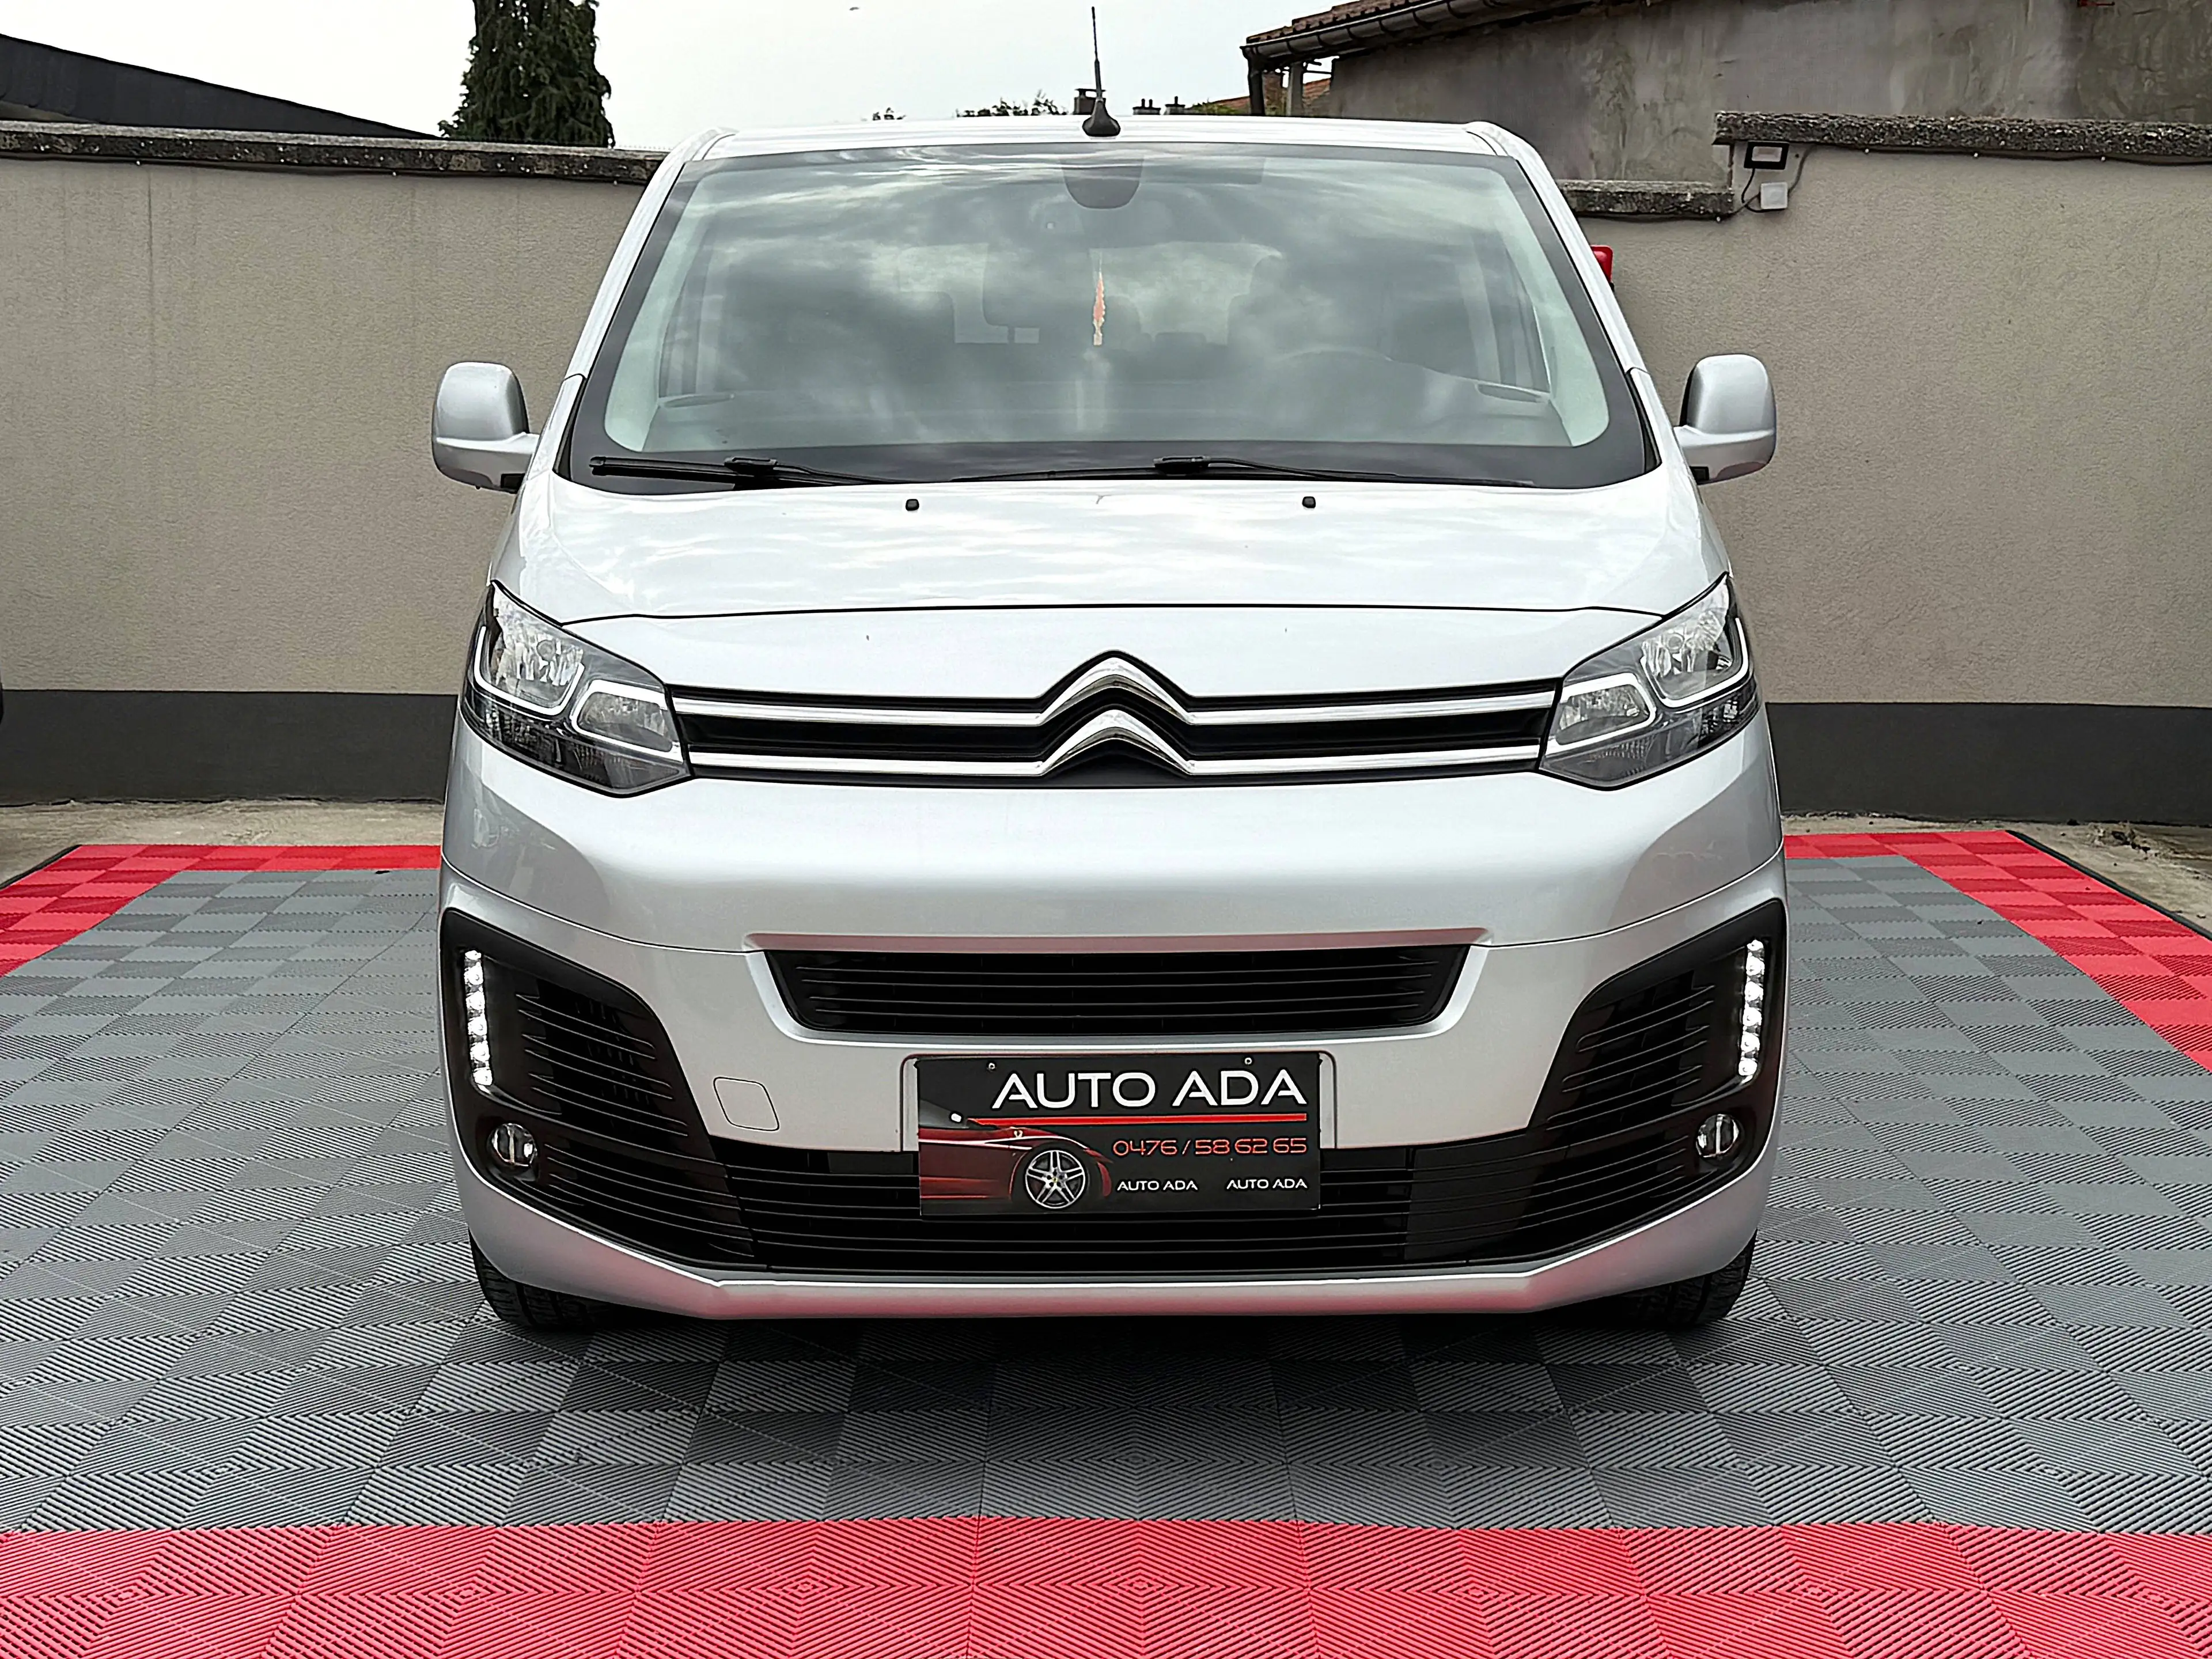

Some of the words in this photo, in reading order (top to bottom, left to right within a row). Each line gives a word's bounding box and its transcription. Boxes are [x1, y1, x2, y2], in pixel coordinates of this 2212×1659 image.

[992, 1072, 1156, 1109] AUTO
[1172, 1069, 1307, 1107] ADA
[1113, 1139, 1177, 1156] 0476
[1195, 1139, 1230, 1154] 58
[1234, 1138, 1268, 1154] 62
[1273, 1138, 1307, 1153] 65
[1117, 1180, 1160, 1191] AUTO
[1162, 1180, 1198, 1191] ADA
[1226, 1179, 1269, 1190] AUTO
[1272, 1178, 1308, 1189] ADA
